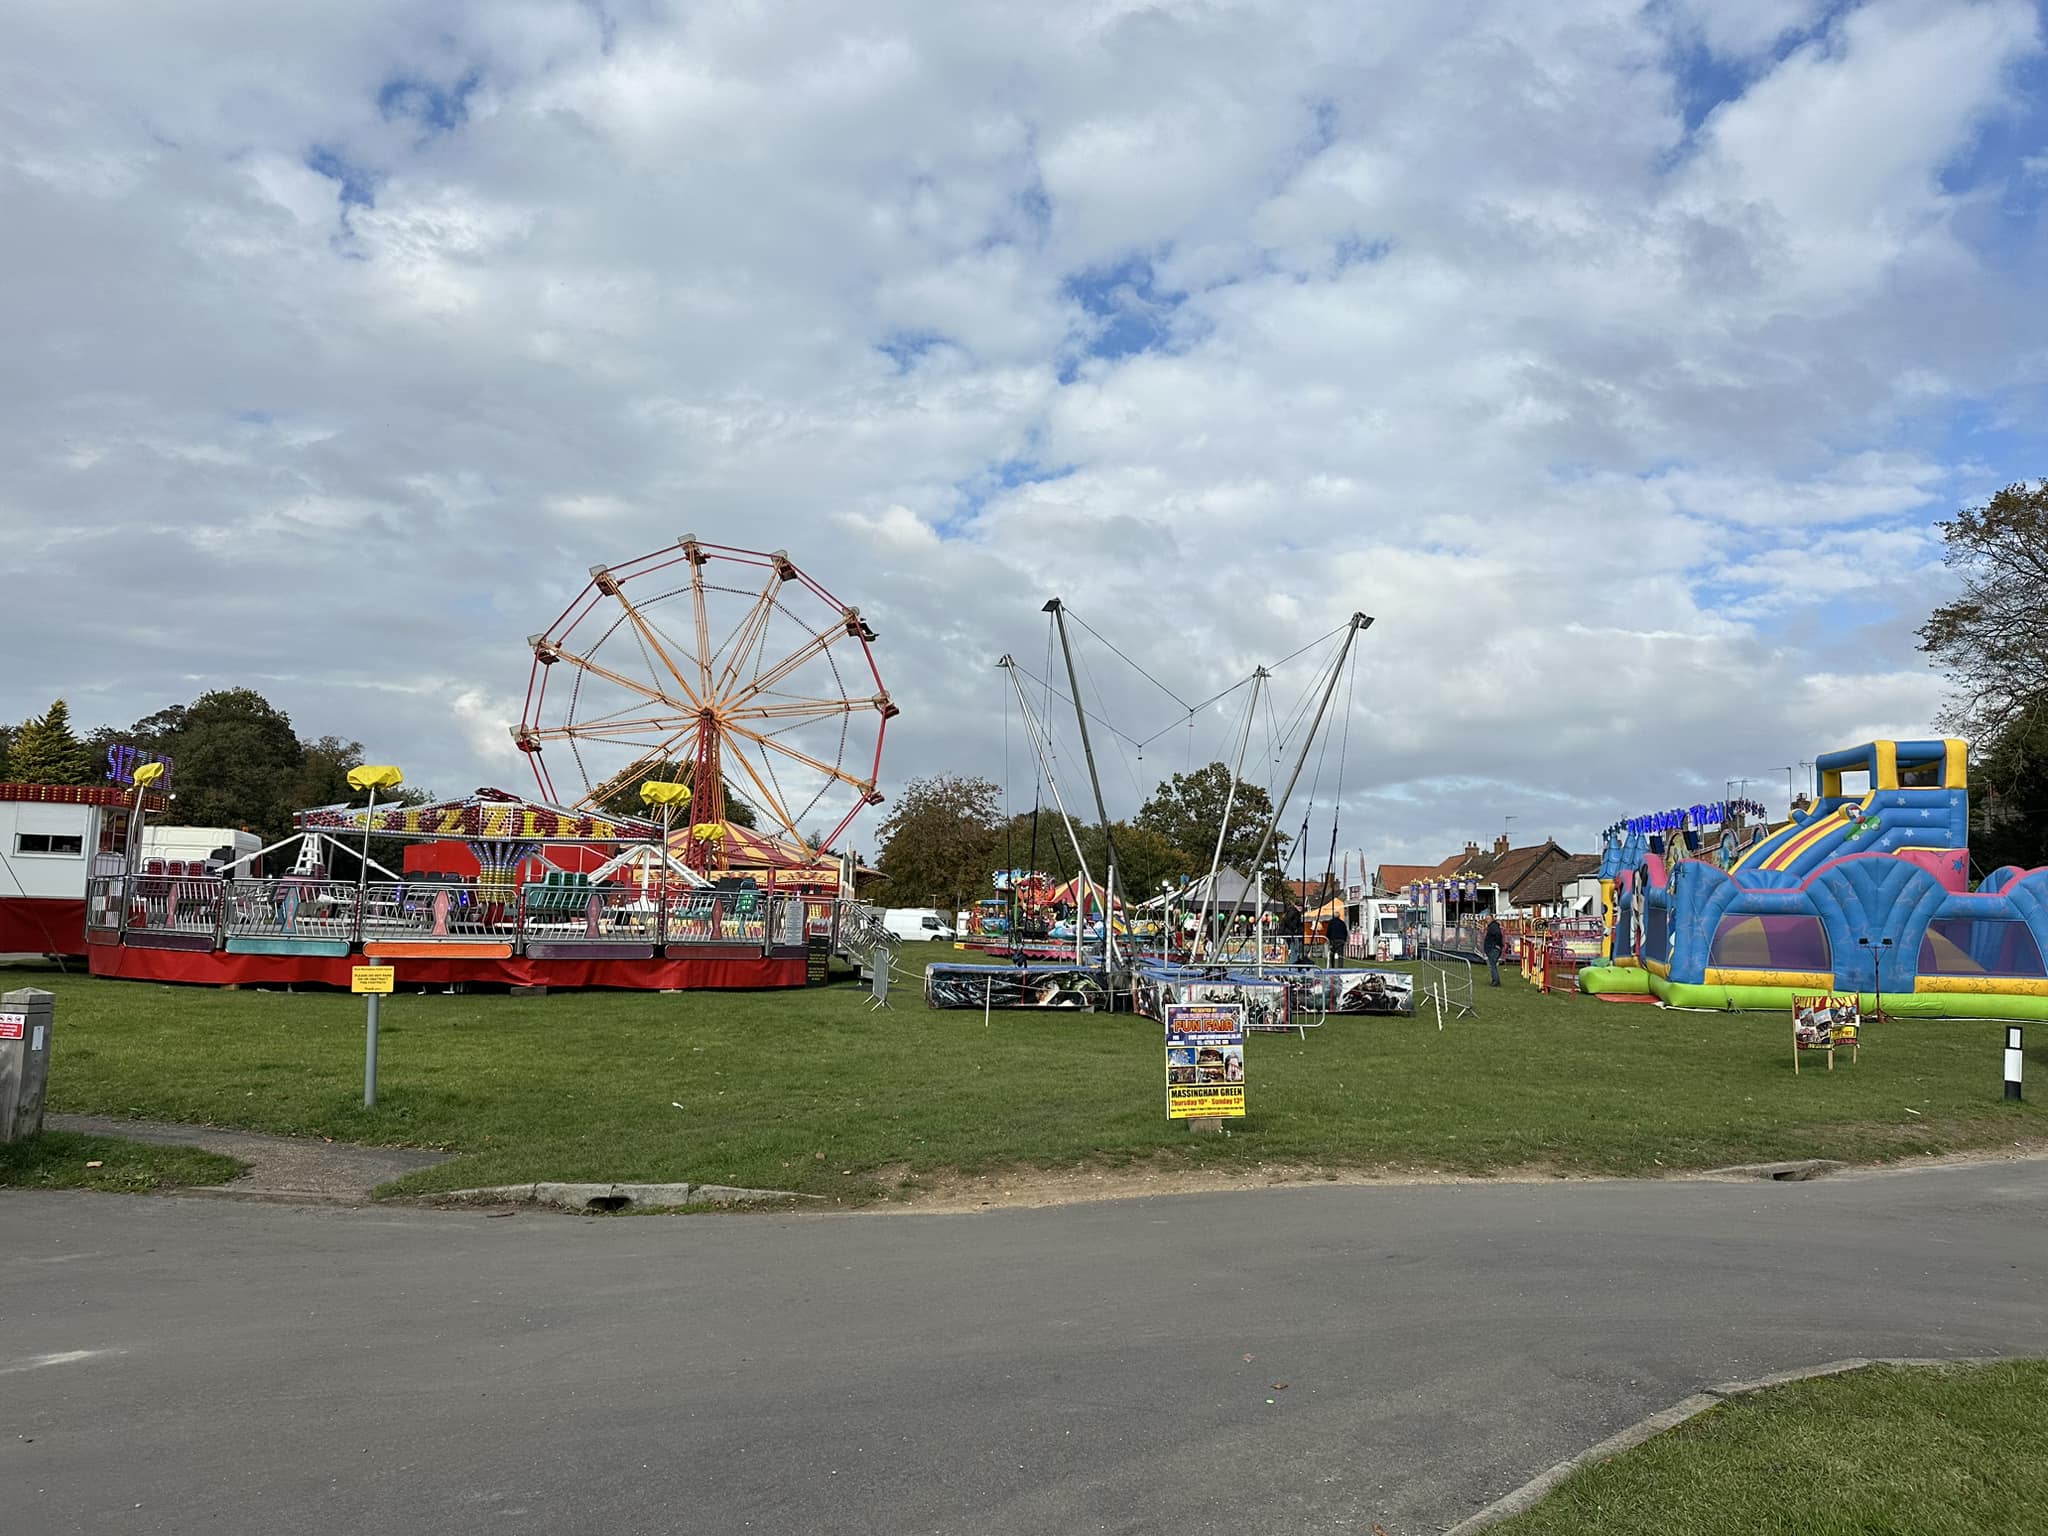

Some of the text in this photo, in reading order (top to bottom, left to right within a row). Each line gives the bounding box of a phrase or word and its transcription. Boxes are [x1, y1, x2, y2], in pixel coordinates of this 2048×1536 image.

[354, 805, 616, 838] SIZZLER
[1627, 800, 1736, 836] RUNAWAY TRAIN
[1173, 1018, 1234, 1033] FUN FAIR
[1171, 1086, 1243, 1098] MASSINGHAM GREEN
